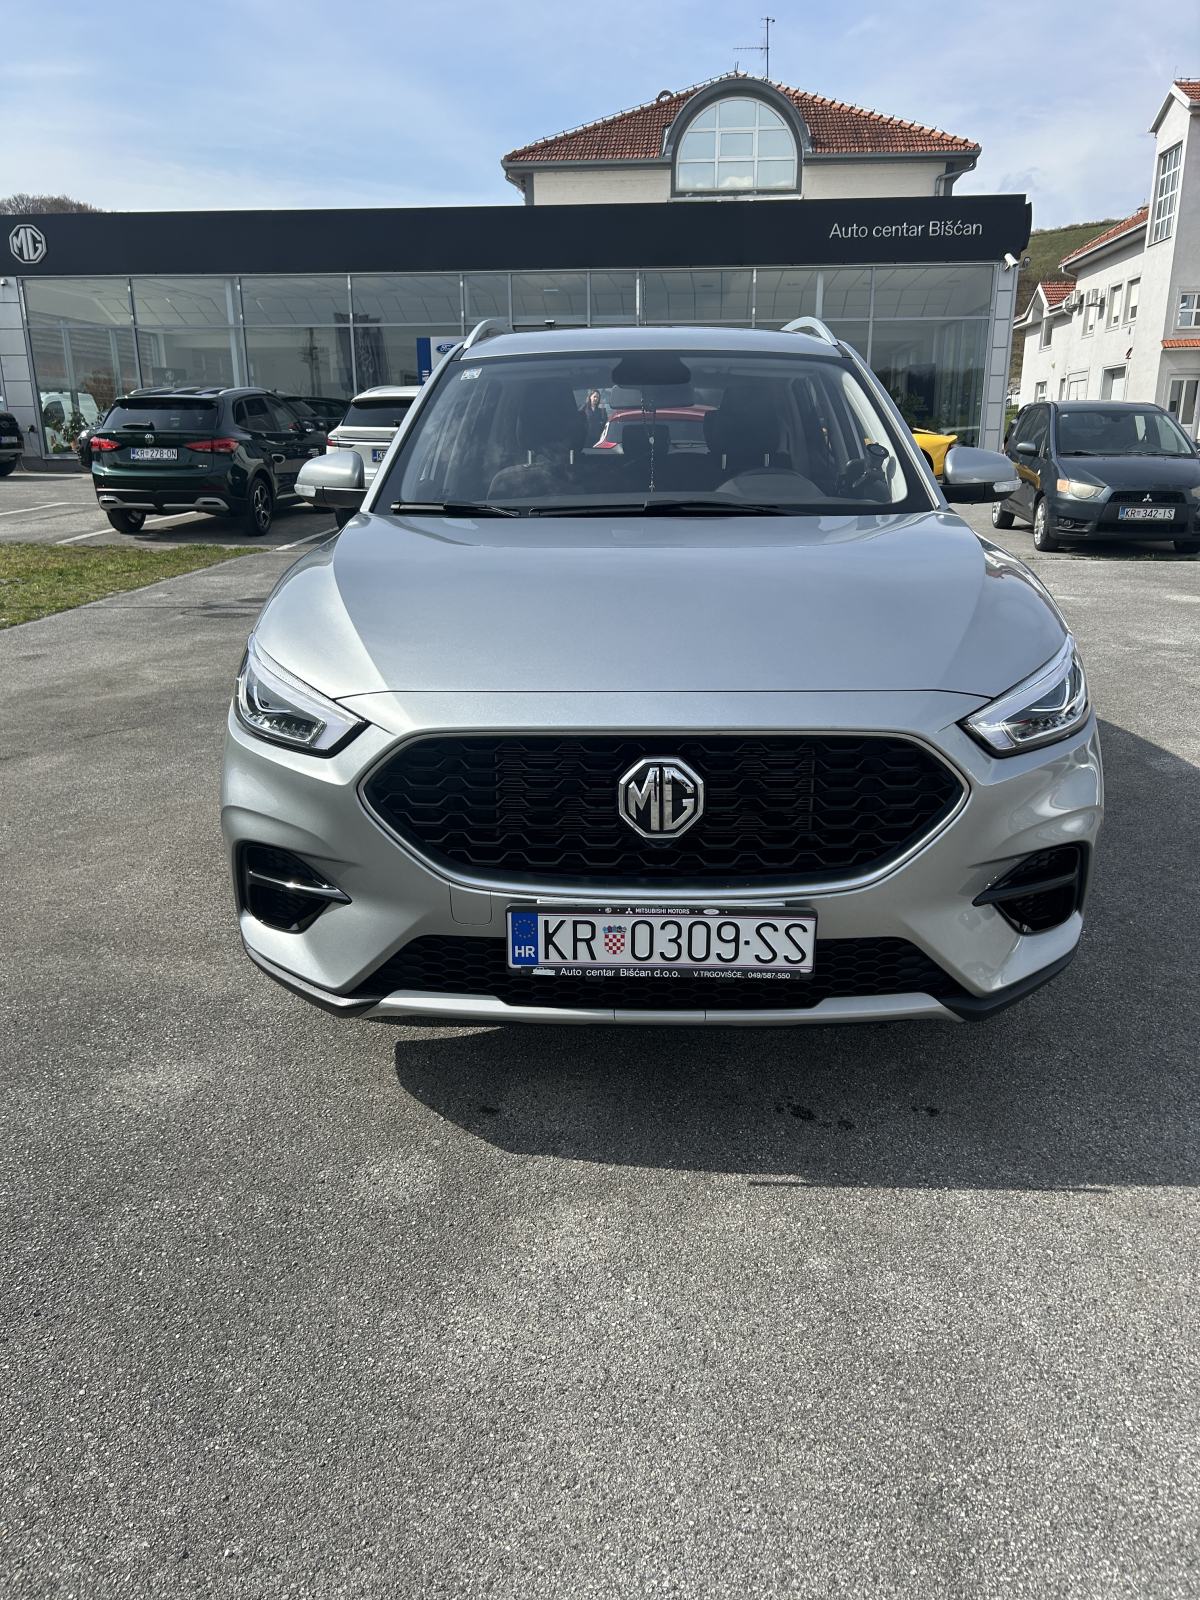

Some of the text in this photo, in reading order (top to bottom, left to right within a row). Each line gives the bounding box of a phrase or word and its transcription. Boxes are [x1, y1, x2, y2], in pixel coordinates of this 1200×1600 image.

[829, 219, 983, 239] Auto centar Bišćan
[12, 227, 43, 260] MG
[627, 766, 695, 831] MG
[635, 907, 690, 916] MITSUBISHI MOTORS
[543, 919, 597, 961] KR
[514, 945, 536, 958] HR
[560, 967, 582, 976] Auto
[586, 968, 615, 977] centar
[620, 967, 651, 977] Bišćan
[654, 968, 681, 978] d.o.o.
